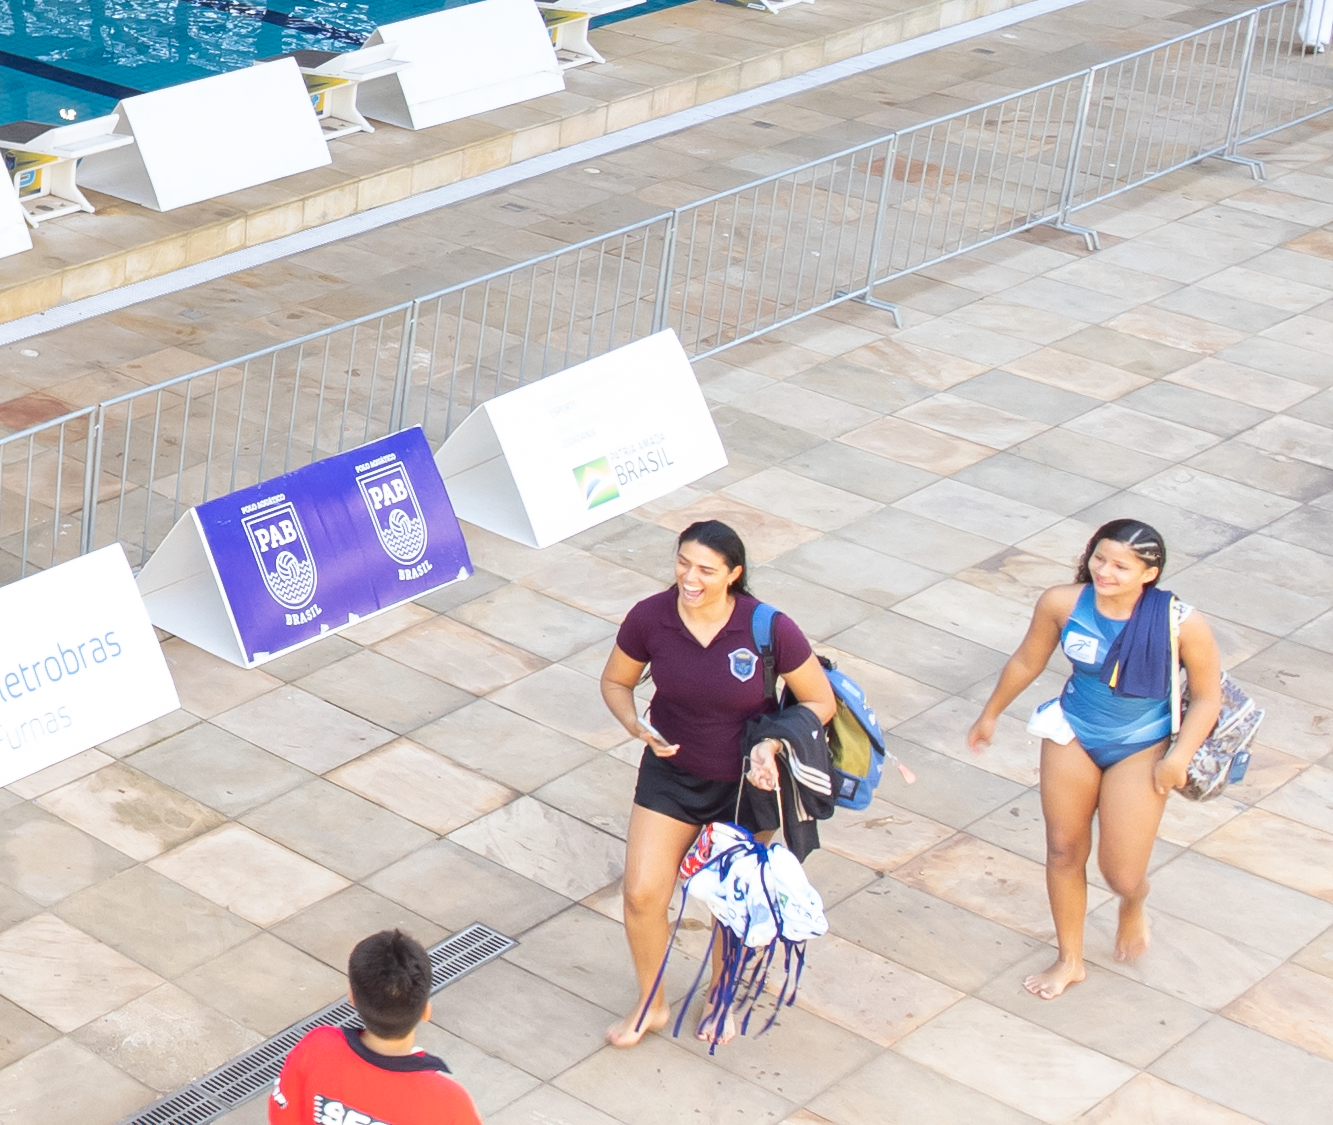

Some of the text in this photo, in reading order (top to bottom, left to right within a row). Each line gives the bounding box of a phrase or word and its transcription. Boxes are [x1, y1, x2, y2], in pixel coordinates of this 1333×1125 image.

[354, 461, 370, 474] POLO
[614, 447, 675, 487] BRASIL
[368, 477, 409, 511] PAB
[240, 502, 257, 515] POLO
[254, 519, 298, 553] PAB
[397, 559, 434, 581] BRASIL
[284, 603, 323, 626] BRASIL
